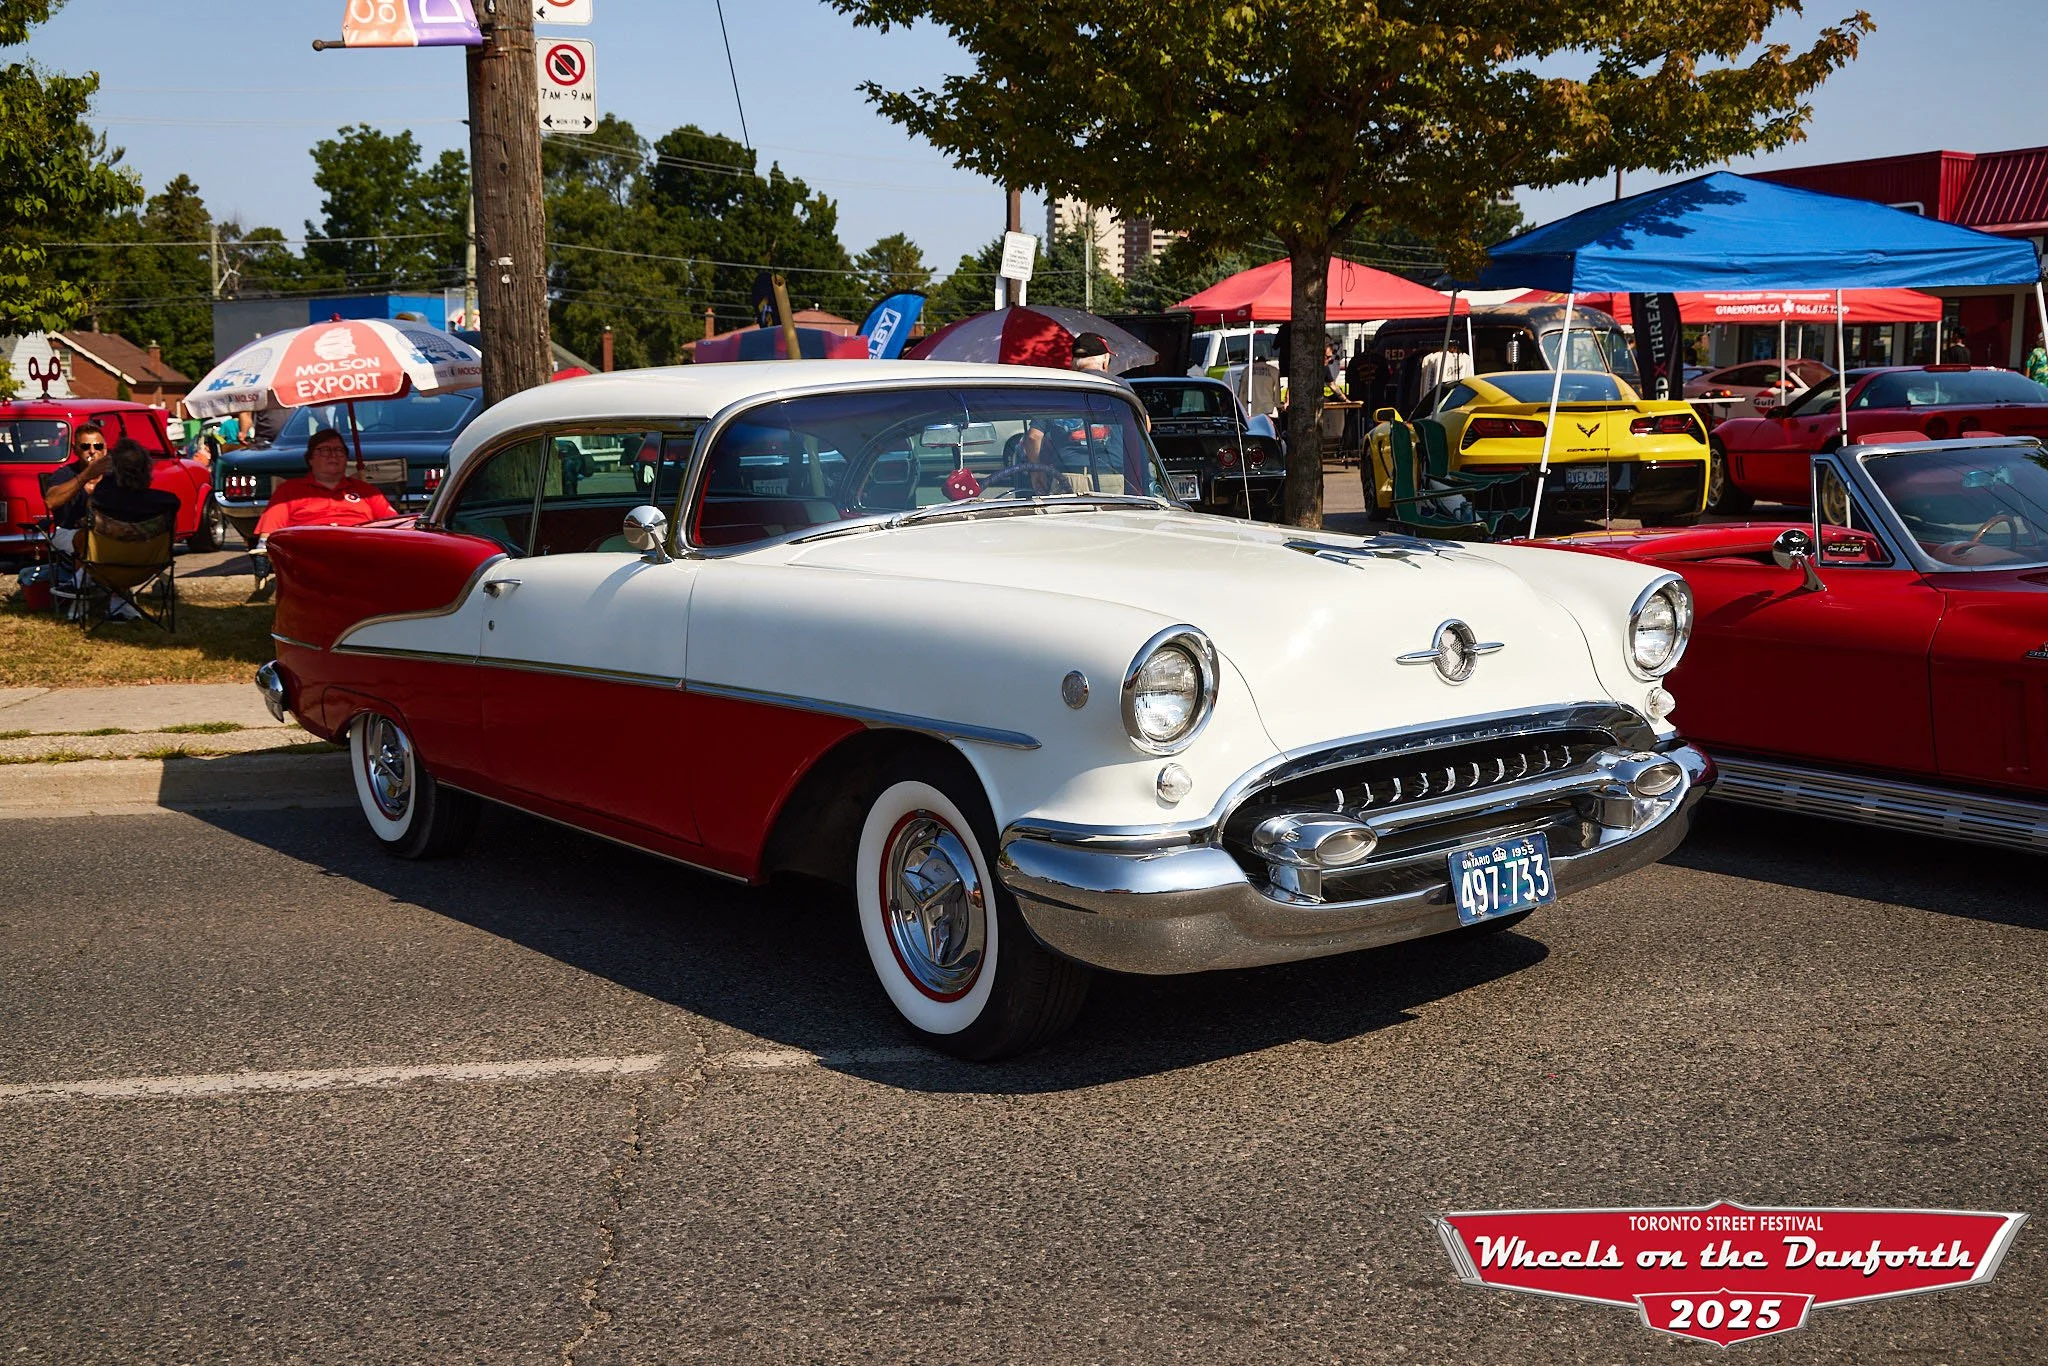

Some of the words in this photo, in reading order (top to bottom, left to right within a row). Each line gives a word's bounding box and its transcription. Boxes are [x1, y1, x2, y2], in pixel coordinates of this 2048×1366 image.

[541, 87, 547, 99] 7
[550, 91, 561, 100] AM
[571, 89, 578, 100] 9
[581, 92, 592, 101] AM
[1384, 349, 1405, 360] RED
[295, 356, 380, 377] MOLSON
[457, 367, 483, 376] MOLSO
[295, 372, 381, 398] EXPORT
[1753, 398, 1775, 406] Gulf
[1462, 855, 1490, 869] ONTARIO
[1512, 844, 1534, 858] 1955
